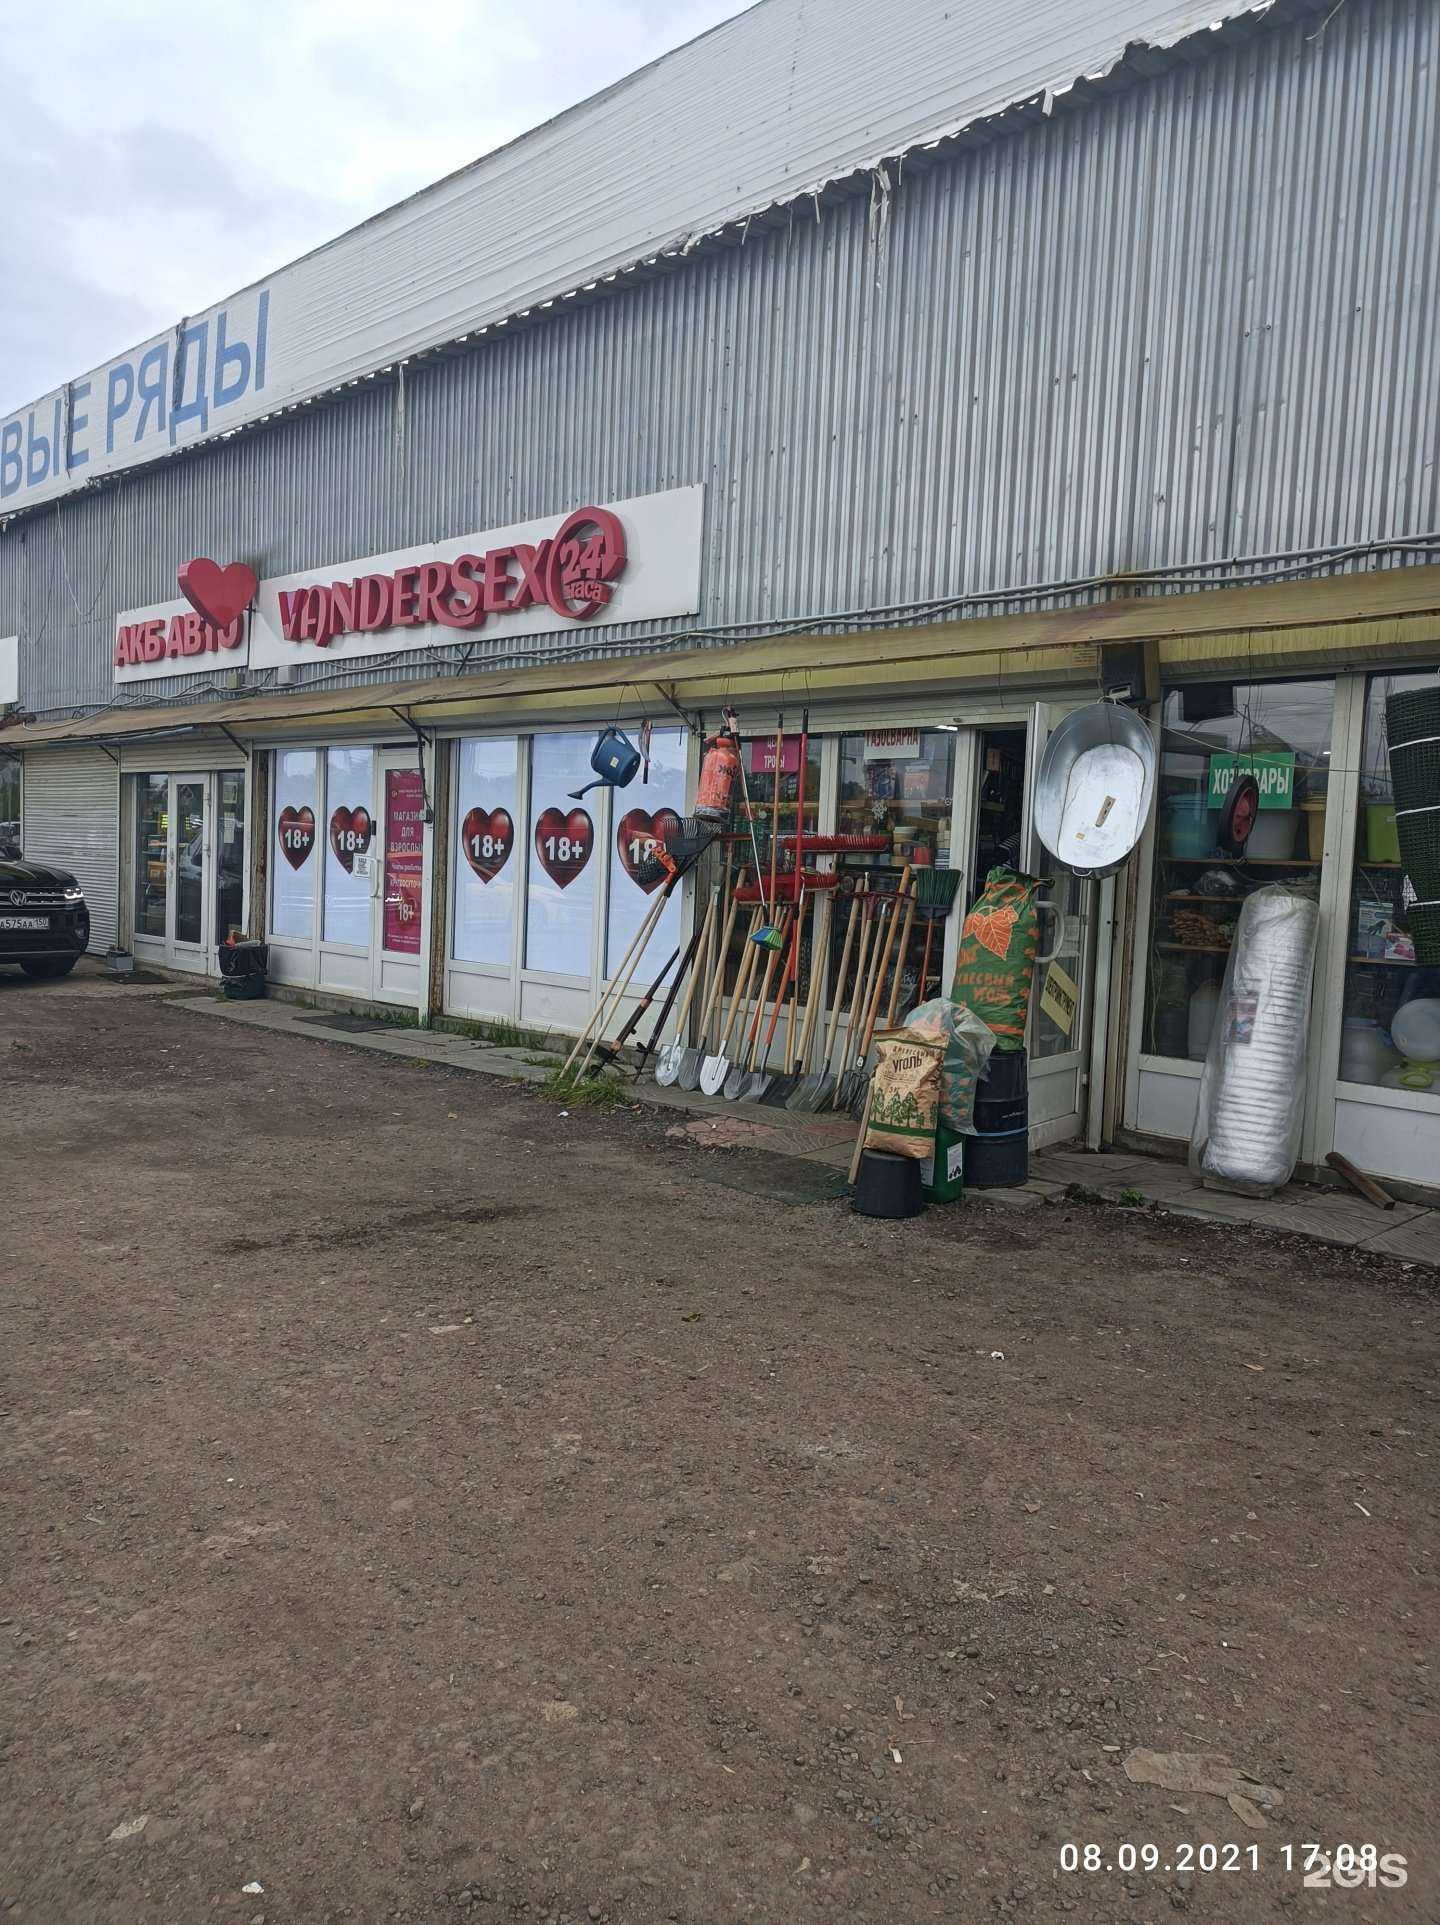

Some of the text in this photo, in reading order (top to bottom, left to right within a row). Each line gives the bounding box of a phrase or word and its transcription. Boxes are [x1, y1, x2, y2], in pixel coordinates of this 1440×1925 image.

[106, 289, 270, 454] РЯДЫ
[558, 534, 604, 583] 24
[278, 539, 554, 648] VANDERSEX
[560, 580, 603, 602] часа
[114, 618, 166, 667] АКБ
[763, 754, 785, 769] ТРОЫ
[1212, 767, 1290, 795] ХОЗВАРЫ
[393, 810, 424, 822] МАГАЗИ
[285, 828, 309, 850] 18+
[337, 830, 365, 852] 18+
[471, 833, 505, 858] 18+
[545, 836, 584, 862] 18+
[398, 904, 414, 922] 18+
